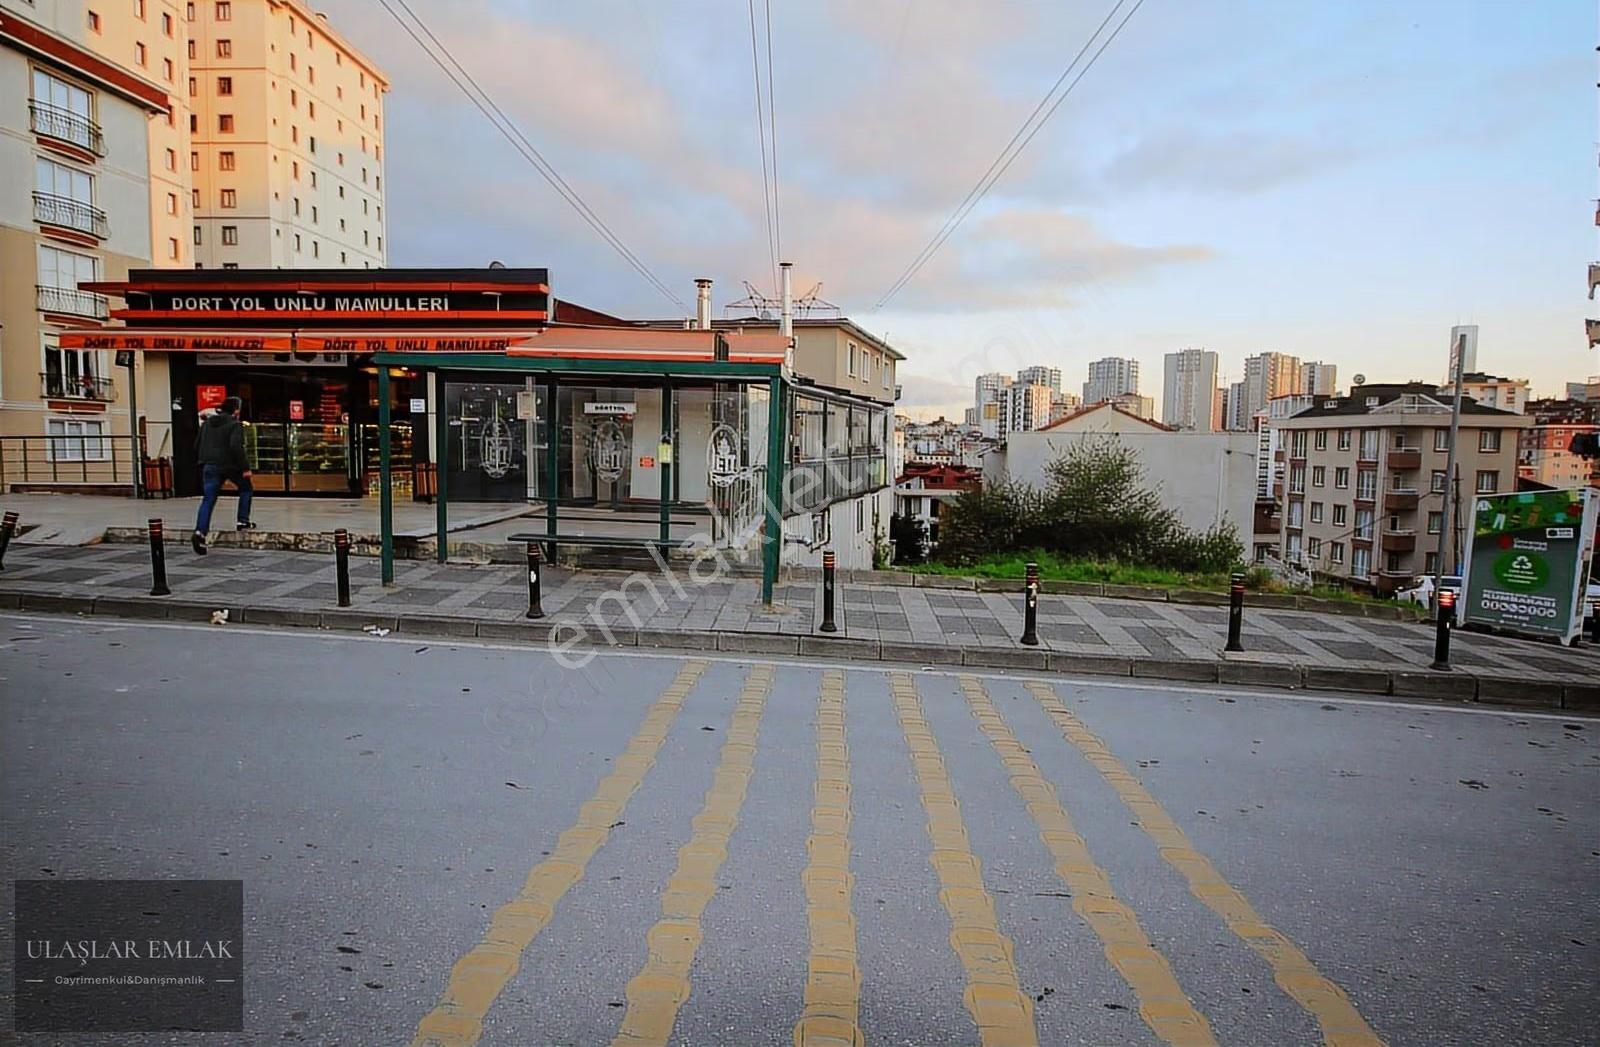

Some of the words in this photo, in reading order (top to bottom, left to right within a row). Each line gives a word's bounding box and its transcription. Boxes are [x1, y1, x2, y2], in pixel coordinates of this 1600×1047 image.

[171, 297, 222, 311] DORT
[229, 297, 265, 311] YOL
[274, 297, 326, 311] UNLU
[124, 338, 145, 349] YOL
[366, 340, 389, 351] YOL
[395, 340, 429, 351] UNLU
